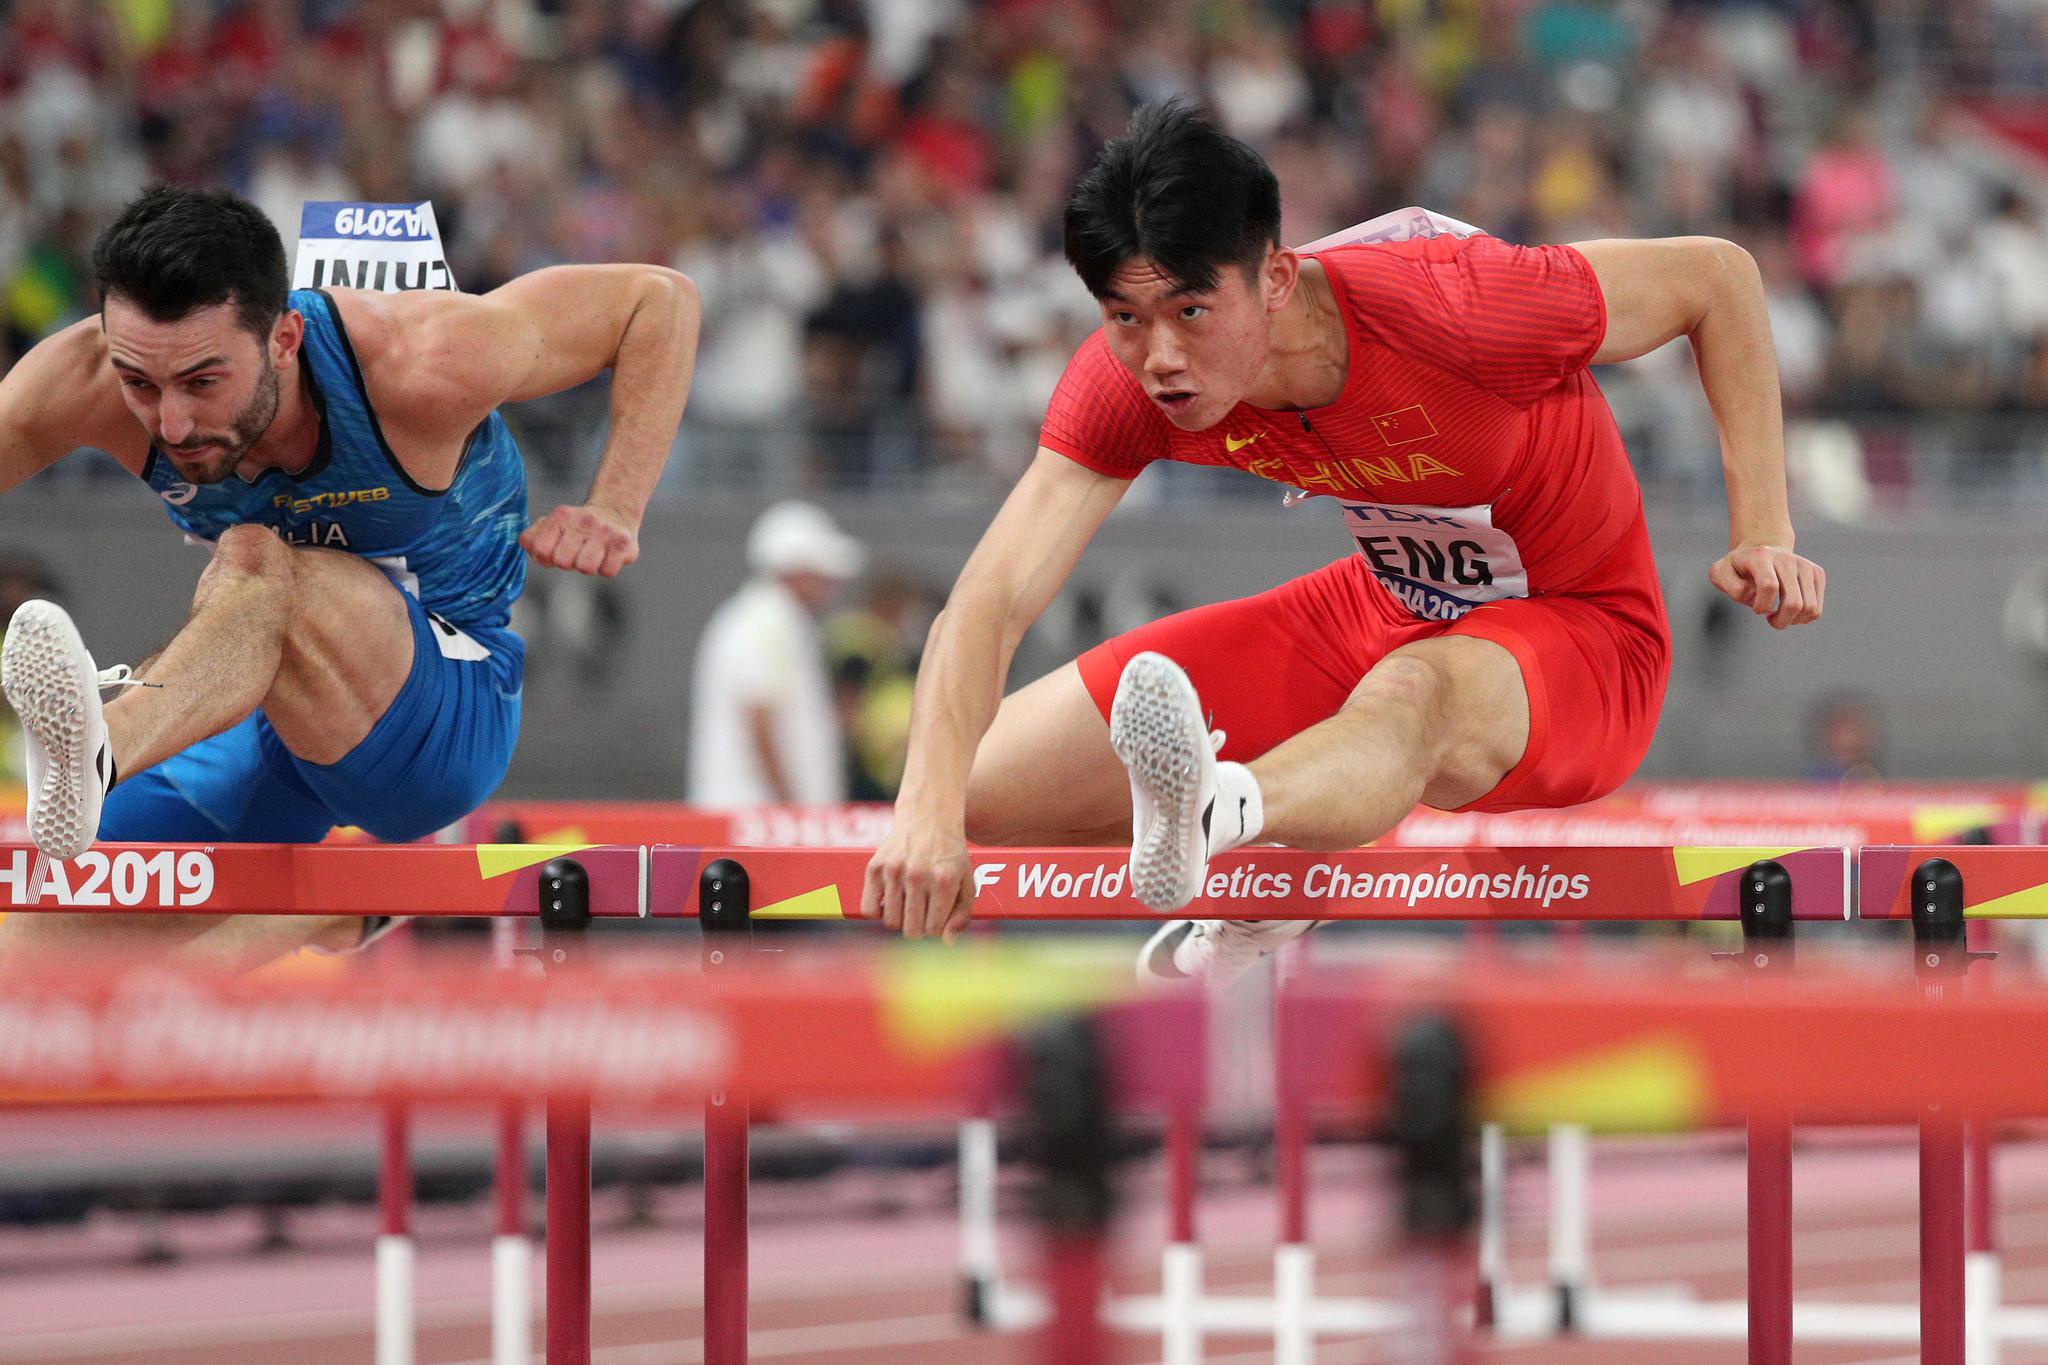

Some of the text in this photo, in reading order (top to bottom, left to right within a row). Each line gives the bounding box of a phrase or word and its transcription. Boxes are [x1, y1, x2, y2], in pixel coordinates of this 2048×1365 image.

[1249, 453, 1464, 491] CHINA
[1343, 505, 1468, 530] TDK
[1355, 535, 1494, 586] ENG
[1017, 863, 1129, 898] World
[1130, 863, 1293, 899] letics
[1302, 863, 1591, 908] Championships
